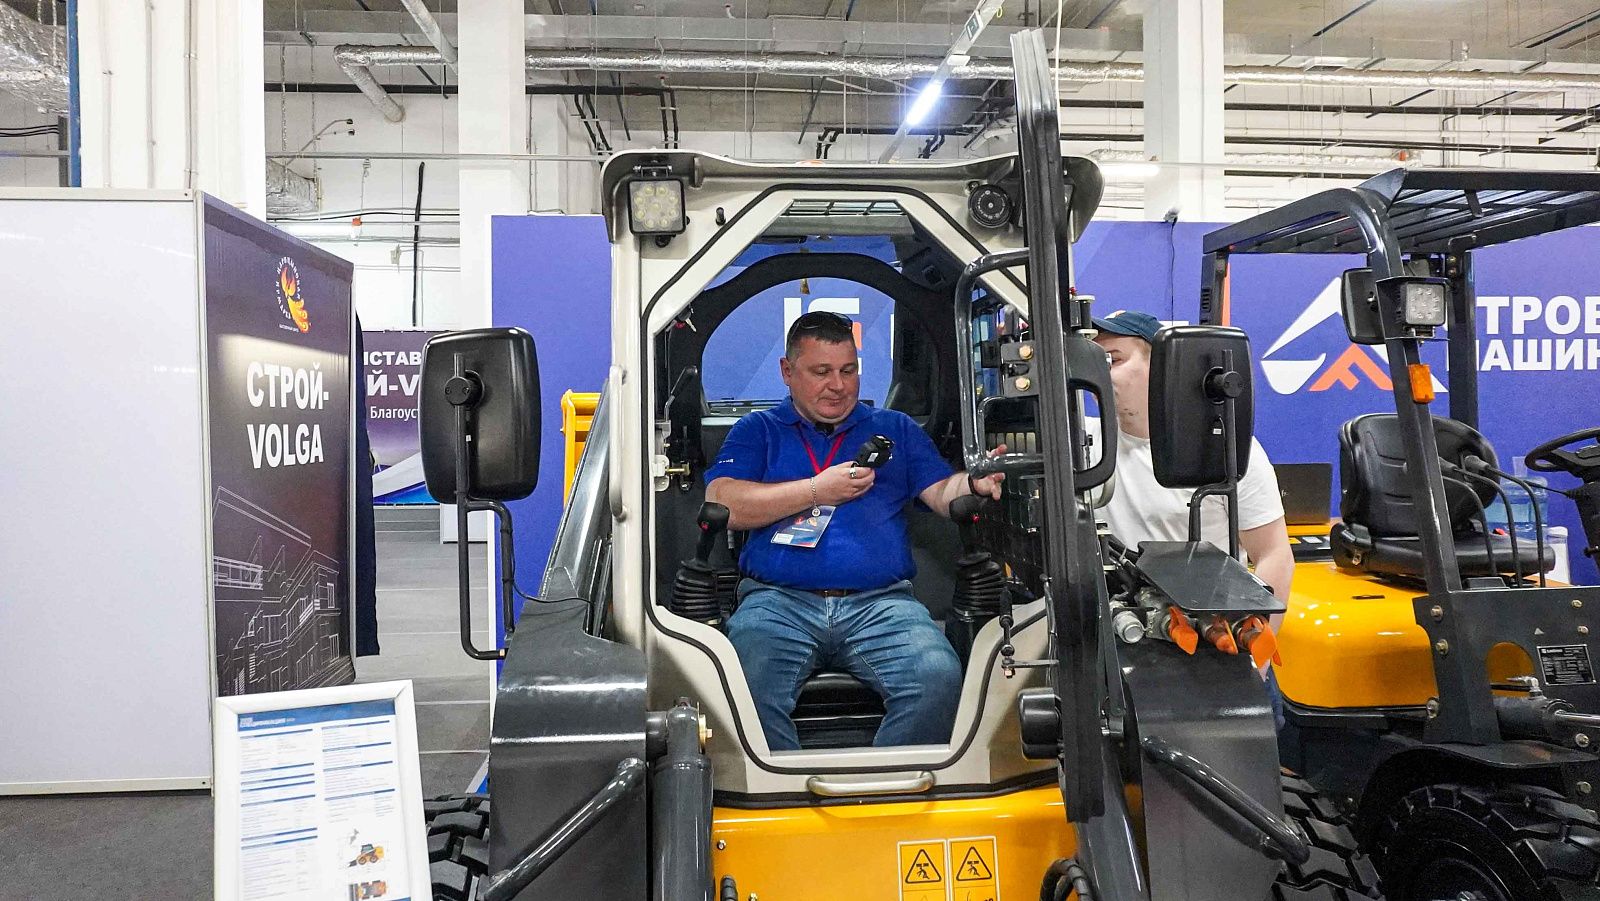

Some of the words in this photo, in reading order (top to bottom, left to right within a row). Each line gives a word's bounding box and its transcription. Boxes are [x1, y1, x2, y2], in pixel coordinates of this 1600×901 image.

[1444, 294, 1600, 335] ТРО
[1446, 338, 1600, 371] АШИ
[246, 362, 329, 410] СТРОЙ-
[370, 405, 419, 422] Благоус
[246, 423, 325, 470] VOLGA
